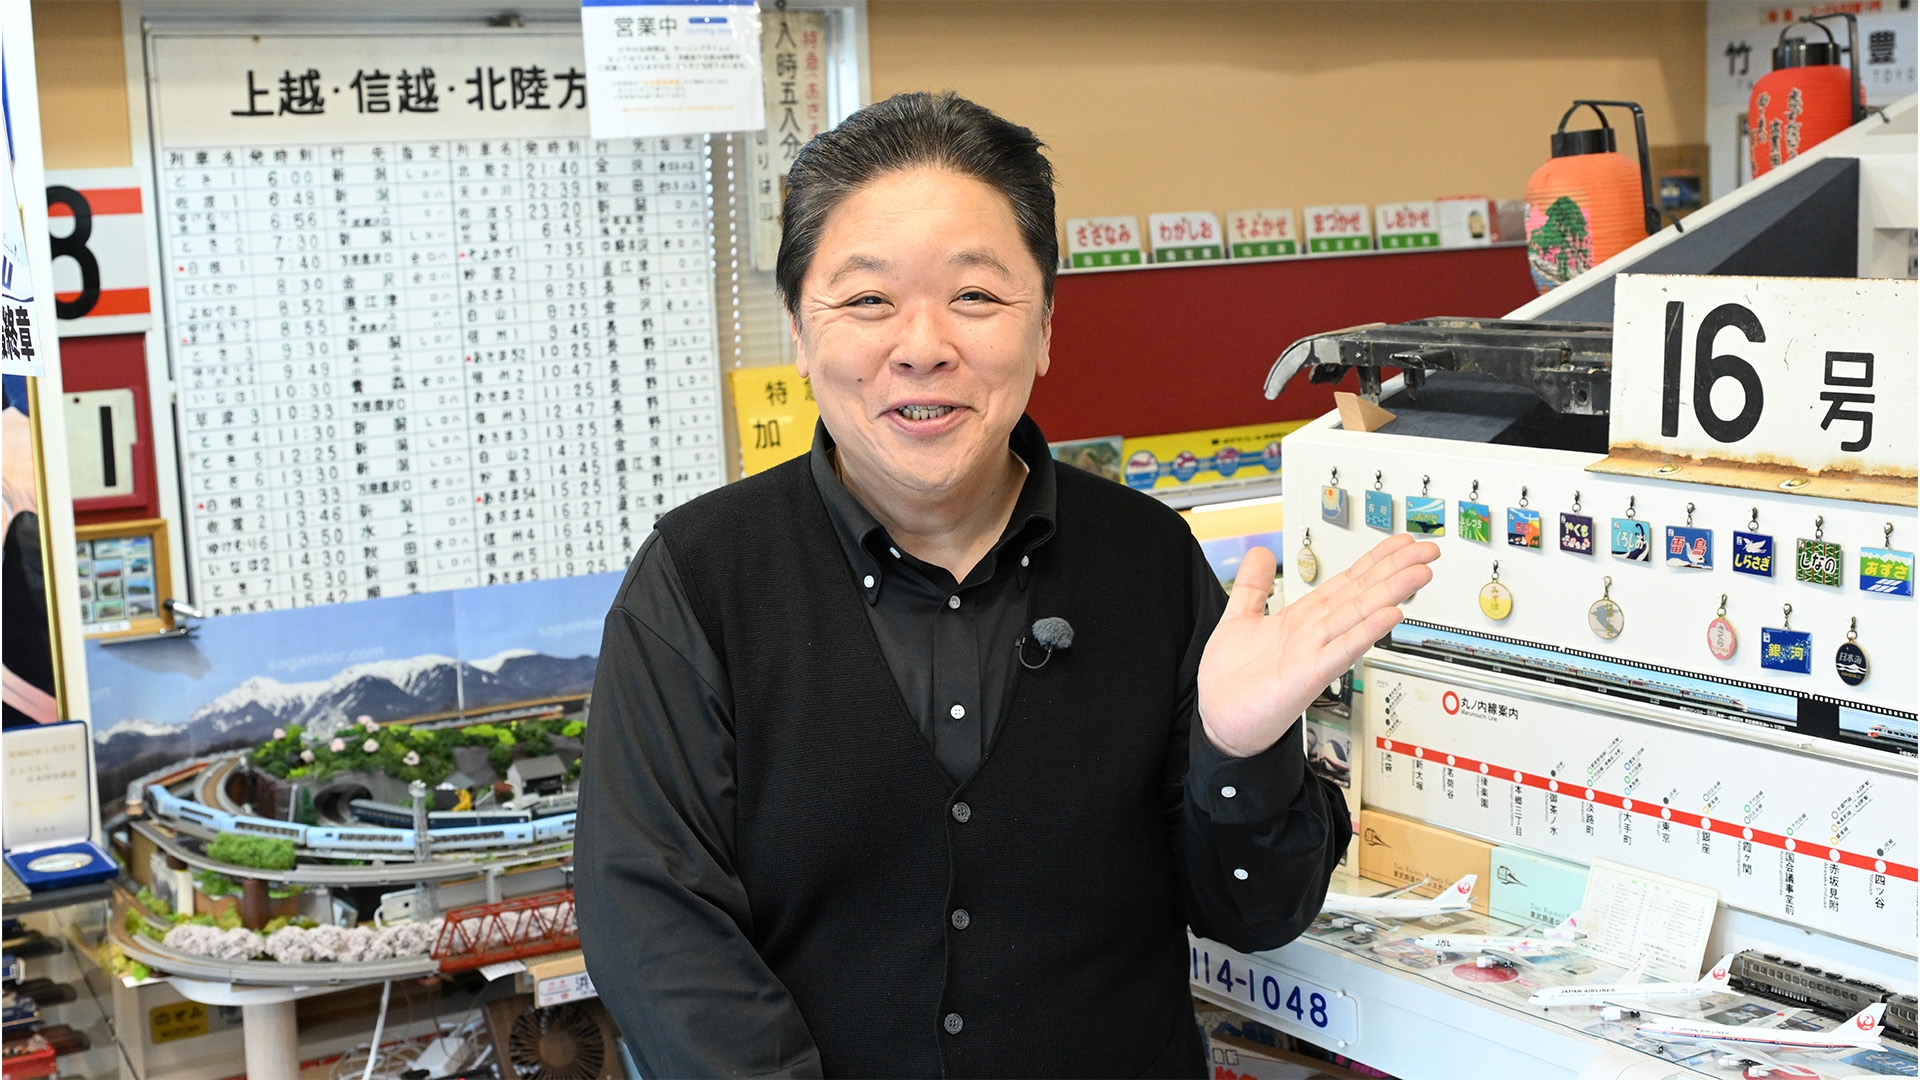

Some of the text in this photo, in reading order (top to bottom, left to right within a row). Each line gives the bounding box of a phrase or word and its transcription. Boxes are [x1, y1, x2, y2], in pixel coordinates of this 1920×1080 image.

[613, 16, 678, 37] 営業中
[267, 170, 312, 187] 6:00
[526, 161, 579, 179] 21:40
[268, 189, 314, 206] 6:48
[527, 180, 580, 199] 22:39
[270, 211, 317, 229] 6:56
[528, 201, 581, 220] 23:20
[542, 219, 582, 237] 6:45
[273, 233, 318, 250] 7:30
[544, 241, 584, 256] 7:35
[275, 254, 320, 272] 7:40
[545, 262, 585, 278] 7:51
[276, 277, 323, 295] 8:30
[545, 281, 587, 297] 8:25
[278, 298, 324, 316] 8:52
[280, 319, 326, 336] 8:55
[549, 322, 590, 340] 9:45
[281, 341, 328, 359] 9:30
[540, 342, 591, 358] 10:25
[283, 362, 330, 379] 9:49
[542, 362, 591, 379] 10:47
[275, 381, 332, 399] 10:30
[544, 381, 594, 399] 11:25
[276, 403, 333, 421] 10:33
[545, 401, 594, 418] 12:47
[278, 425, 335, 442] 11:30
[546, 421, 597, 438] 13:25
[753, 421, 781, 449] 加
[100, 405, 117, 487] 1
[280, 445, 337, 463] 12:25
[548, 441, 599, 458] 14:25
[281, 465, 338, 484] 13:30
[550, 459, 600, 478] 14:45
[284, 486, 340, 505] 13:33
[551, 478, 602, 497] 15:25
[286, 506, 341, 527] 13:46
[553, 501, 602, 519] 16:27
[287, 528, 343, 549] 13:50
[554, 520, 604, 539] 16:45
[1564, 522, 1590, 538] やくも
[555, 539, 605, 558] 18:44
[1616, 530, 1648, 550] くろしお
[1670, 536, 1707, 557] 雷鳥
[289, 550, 345, 568] 14:30
[556, 559, 607, 577] 19:25
[1734, 553, 1772, 573] しらさぎ
[1799, 552, 1836, 575] しなの
[291, 569, 346, 590] 15:30
[1864, 561, 1909, 580] あずさ
[1768, 643, 1805, 662] 銀河
[1838, 652, 1863, 665] 日本海
[1460, 697, 1519, 720] 丸ノ内線案内
[1460, 709, 1487, 720] Marunouchi
[1385, 752, 1393, 772] 池袋
[1416, 759, 1424, 791] 新大塚
[1446, 767, 1455, 799] 茗荷谷
[1480, 776, 1489, 808] 後楽園
[1514, 785, 1523, 836] 本郷三丁目
[1549, 793, 1558, 836] 御茶ノ水
[1585, 802, 1595, 836] 淡路町
[1623, 812, 1633, 846] 大手町
[1661, 821, 1671, 844] 東京
[1702, 830, 1711, 855] 銀座
[1785, 851, 1795, 916] 国会議事堂前
[1828, 863, 1840, 912] 赤坂見附
[1874, 873, 1886, 909] 四ツ谷
[1435, 939, 1452, 948] JAL
[1192, 947, 1329, 1028] 114-1048
